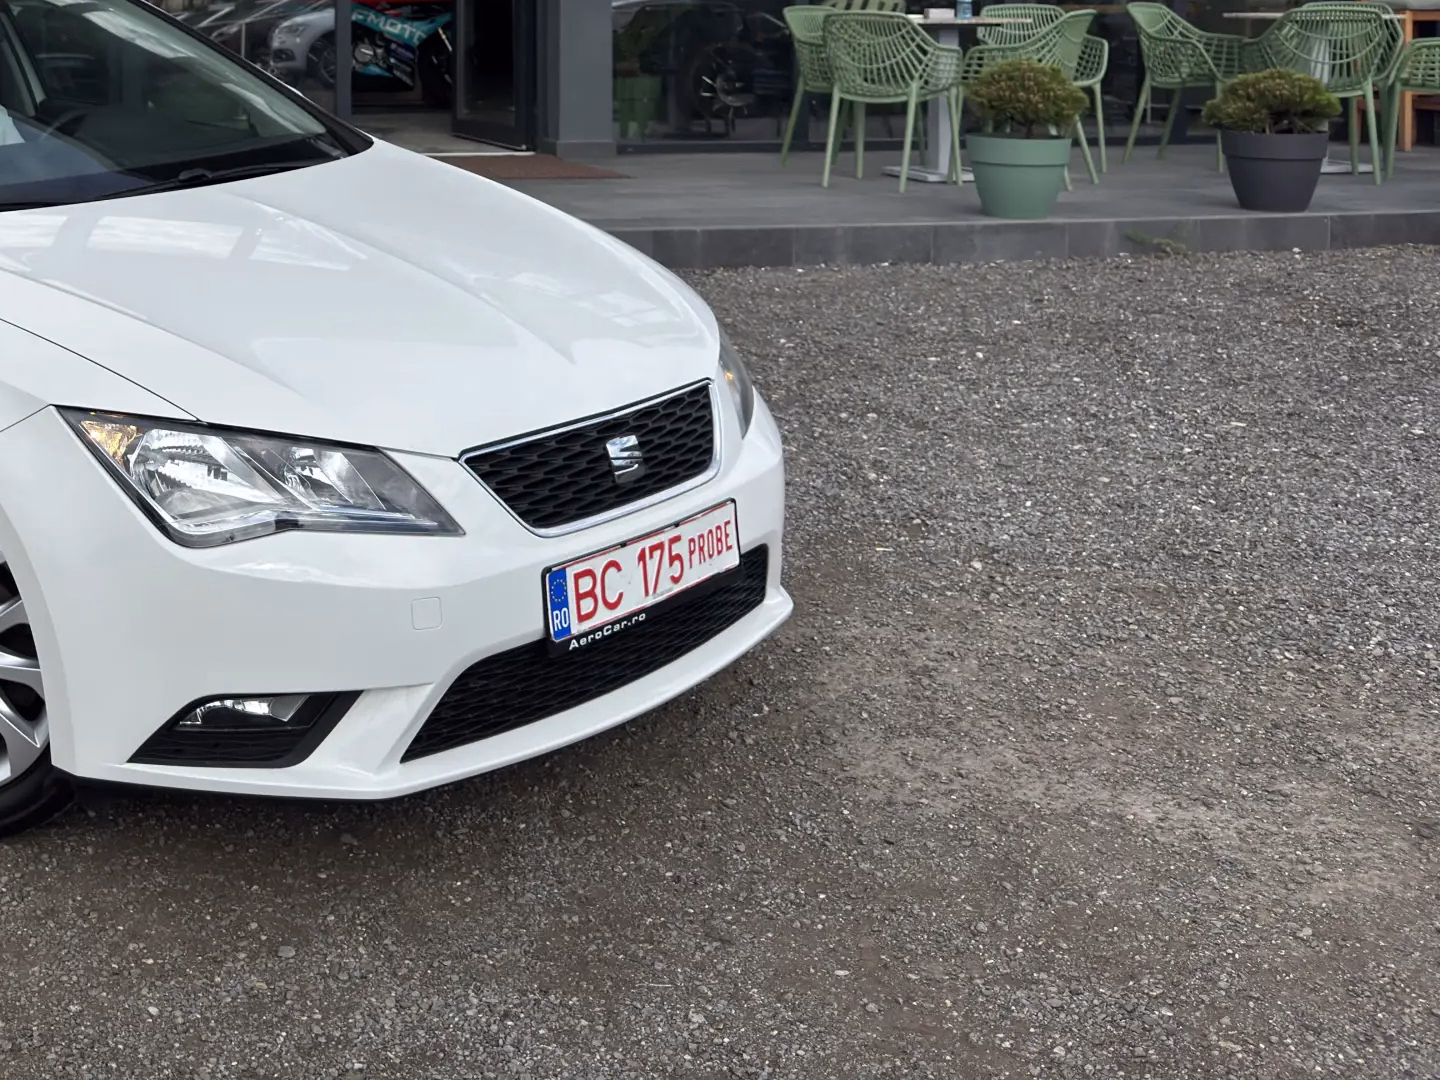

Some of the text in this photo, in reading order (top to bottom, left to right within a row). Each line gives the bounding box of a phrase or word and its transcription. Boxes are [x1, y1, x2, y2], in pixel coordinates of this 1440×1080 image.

[573, 520, 733, 624] BC 175 PROBE
[553, 607, 570, 632] RO
[569, 613, 646, 650] AeroCar.ro
